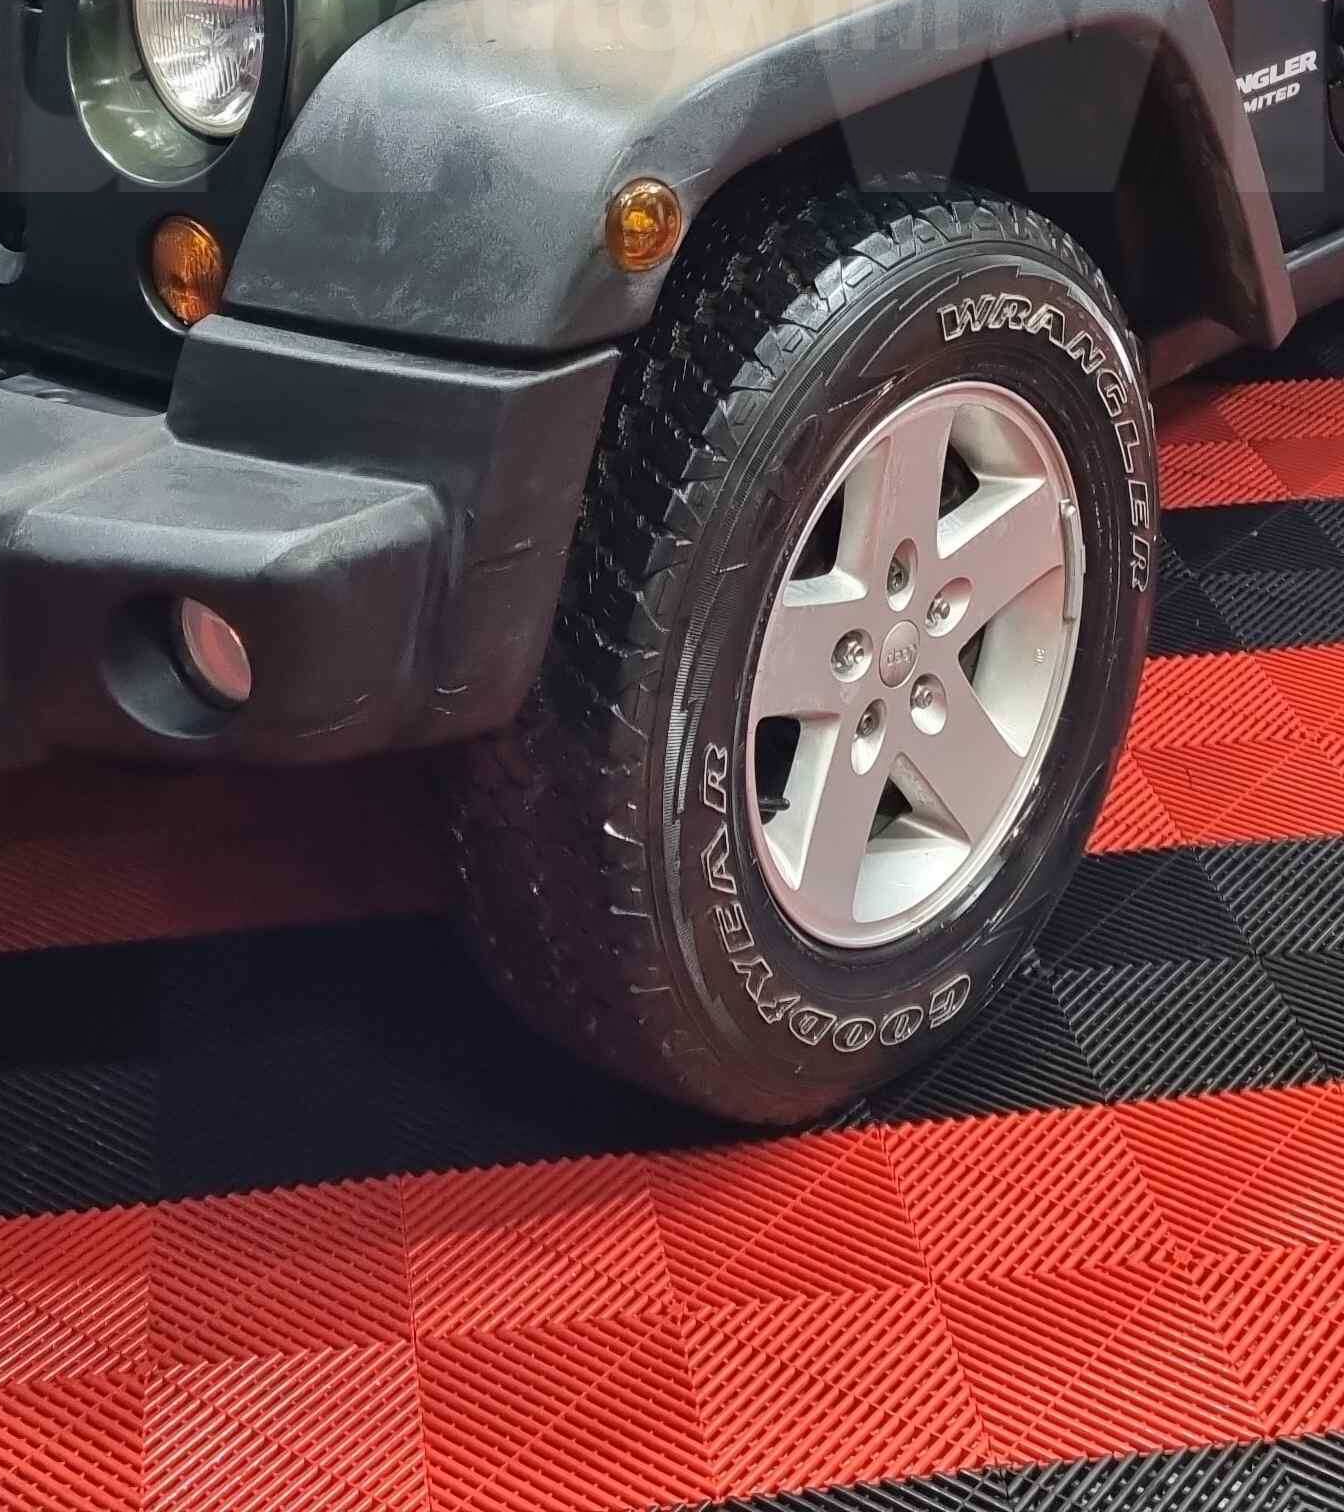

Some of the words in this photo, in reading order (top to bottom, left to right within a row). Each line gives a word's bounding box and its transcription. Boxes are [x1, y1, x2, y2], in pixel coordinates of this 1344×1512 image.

[1235, 50, 1318, 94] NGLER
[1242, 82, 1301, 114] MITED
[937, 292, 1153, 593] WRANGLER
[700, 742, 972, 1053] GOODYEAR
